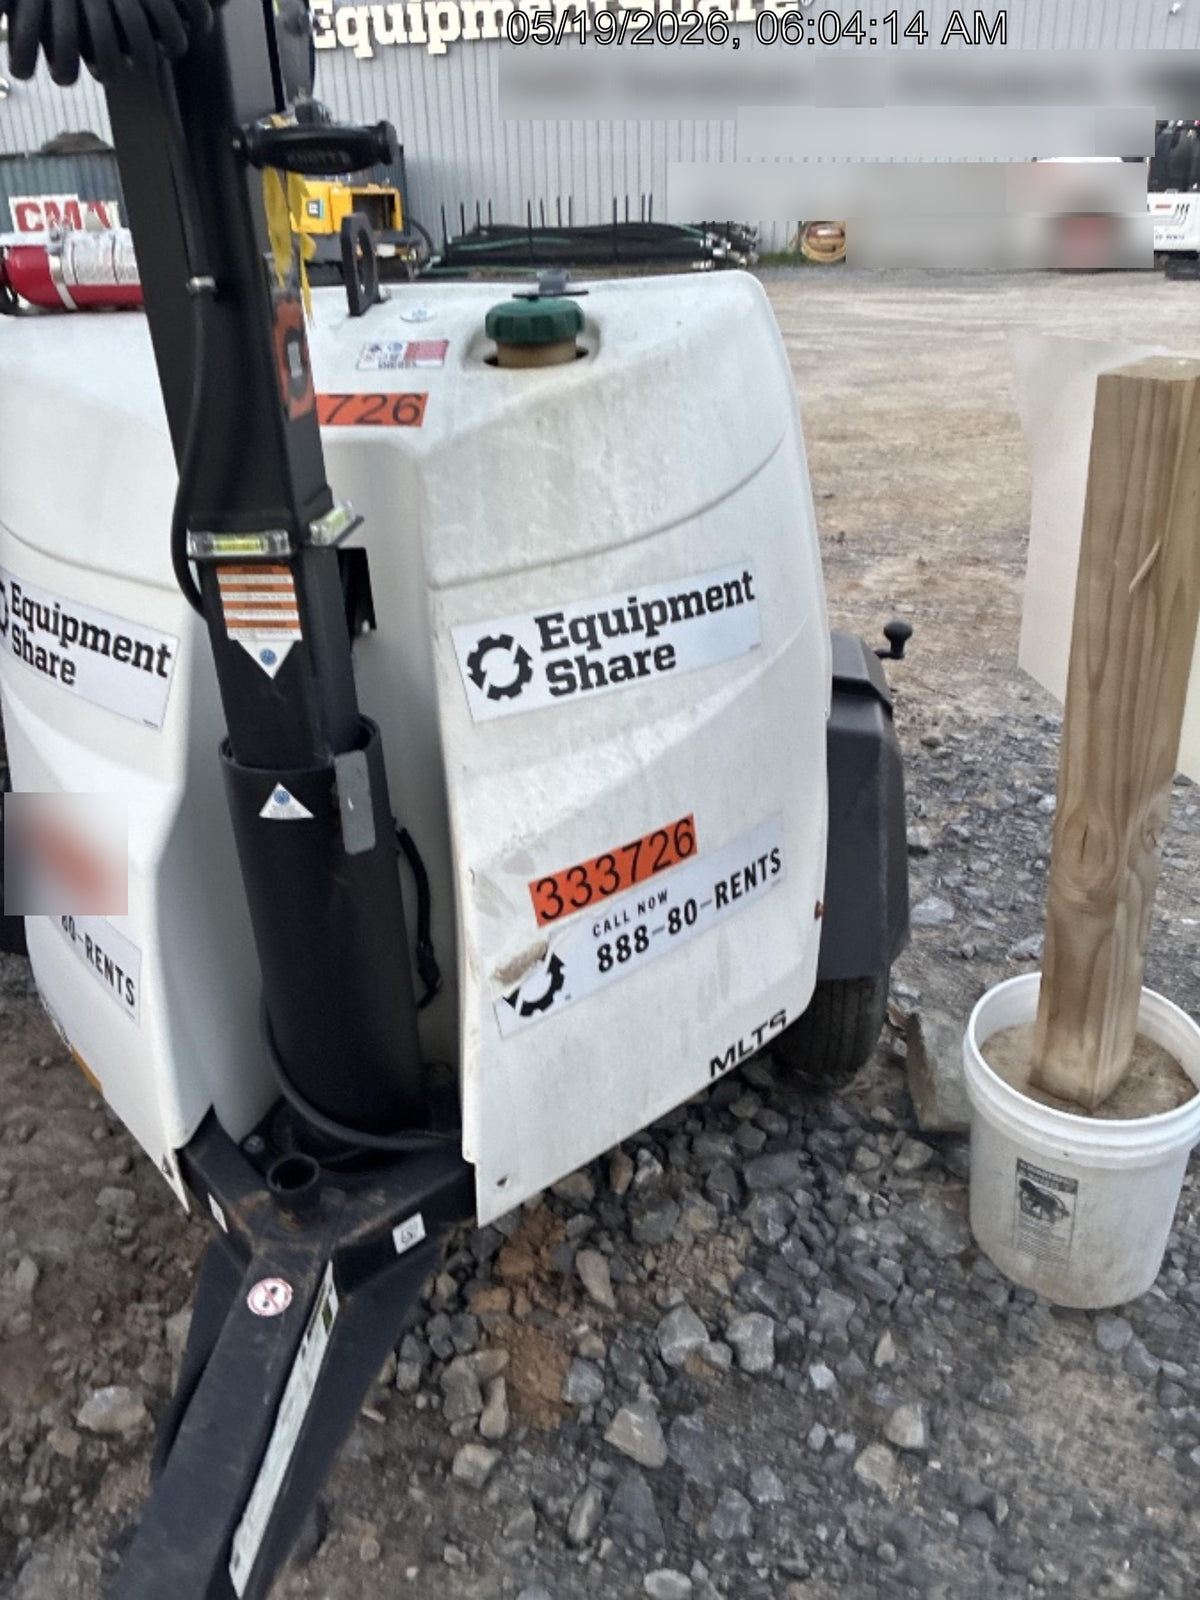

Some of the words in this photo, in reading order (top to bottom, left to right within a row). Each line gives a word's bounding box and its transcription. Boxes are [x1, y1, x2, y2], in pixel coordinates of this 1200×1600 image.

[10, 580, 172, 679] Equipment
[534, 570, 756, 653] Equipment
[12, 622, 76, 686] Share
[545, 643, 677, 698] Share
[536, 818, 696, 921] 333726
[596, 847, 782, 974] 888-80-RENTS
[593, 910, 630, 938] CALL
[638, 888, 668, 917] NOW
